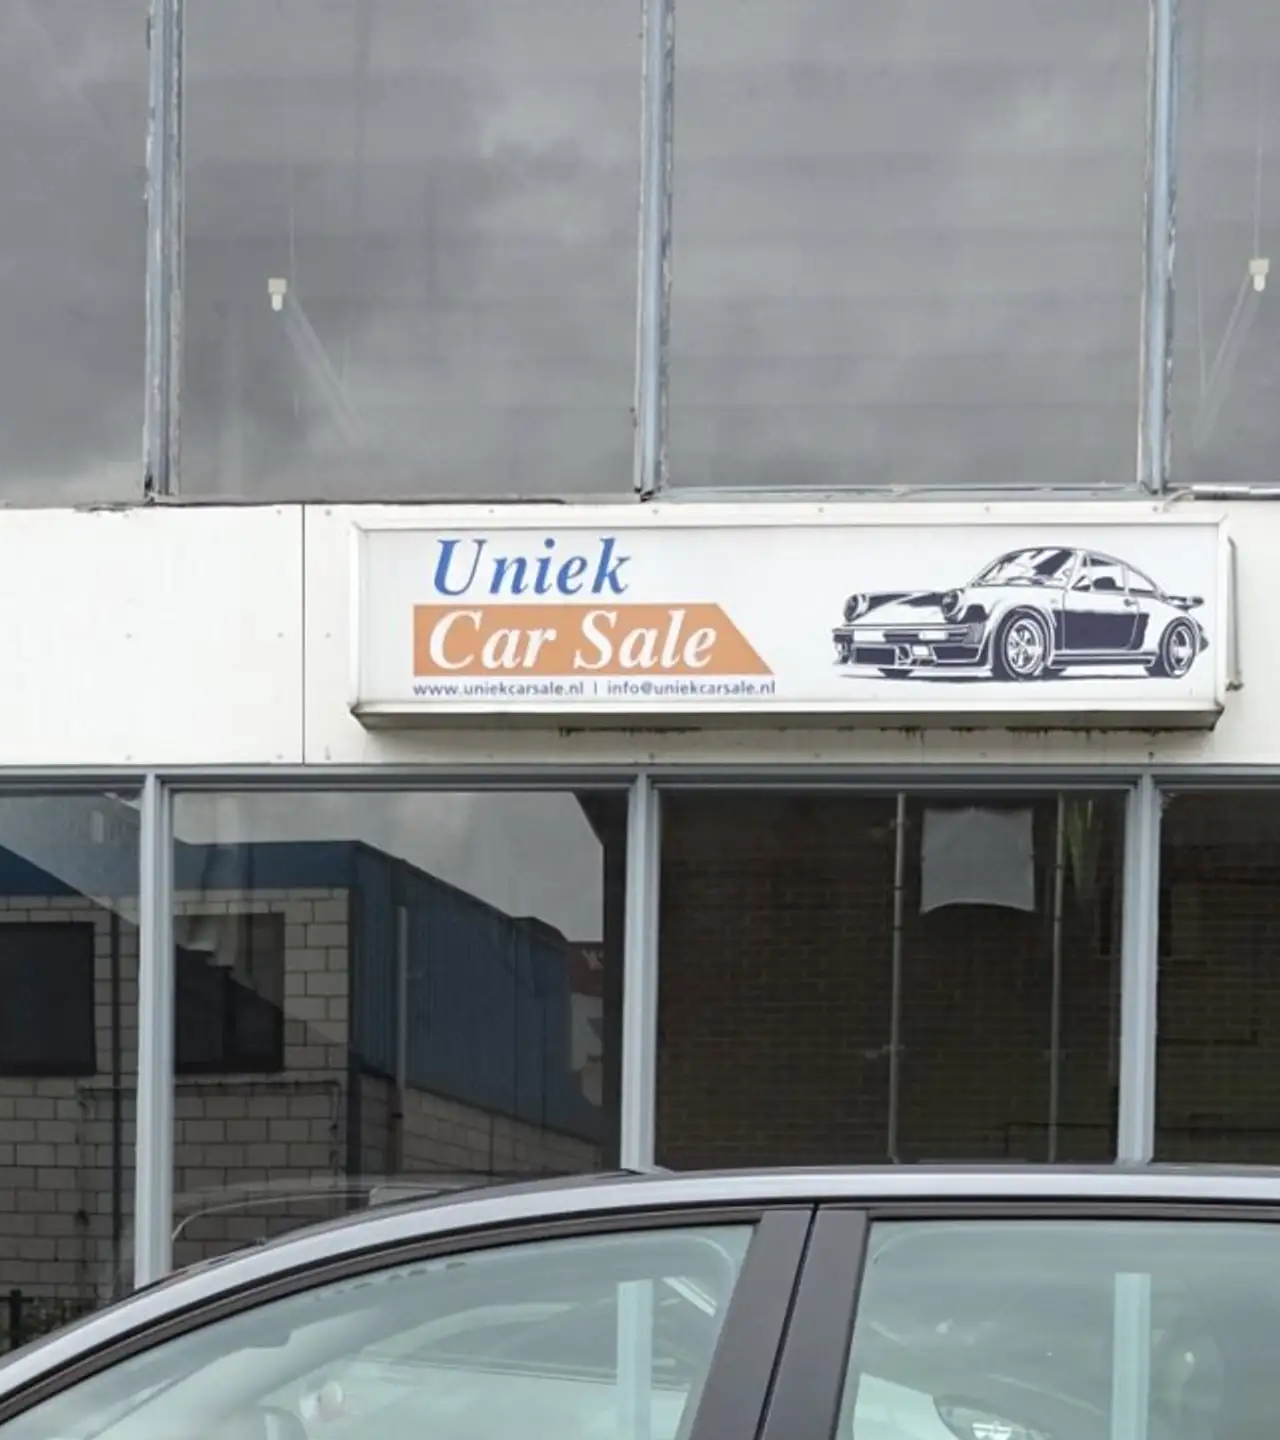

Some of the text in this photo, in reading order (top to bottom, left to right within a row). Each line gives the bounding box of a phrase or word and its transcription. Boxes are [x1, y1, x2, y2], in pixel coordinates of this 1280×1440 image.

[433, 536, 632, 596] Uniek
[429, 608, 718, 670] Car Sale
[412, 680, 584, 697] www.uniekcarsale.nl
[606, 679, 777, 696] info@uniekcarsale.nl
